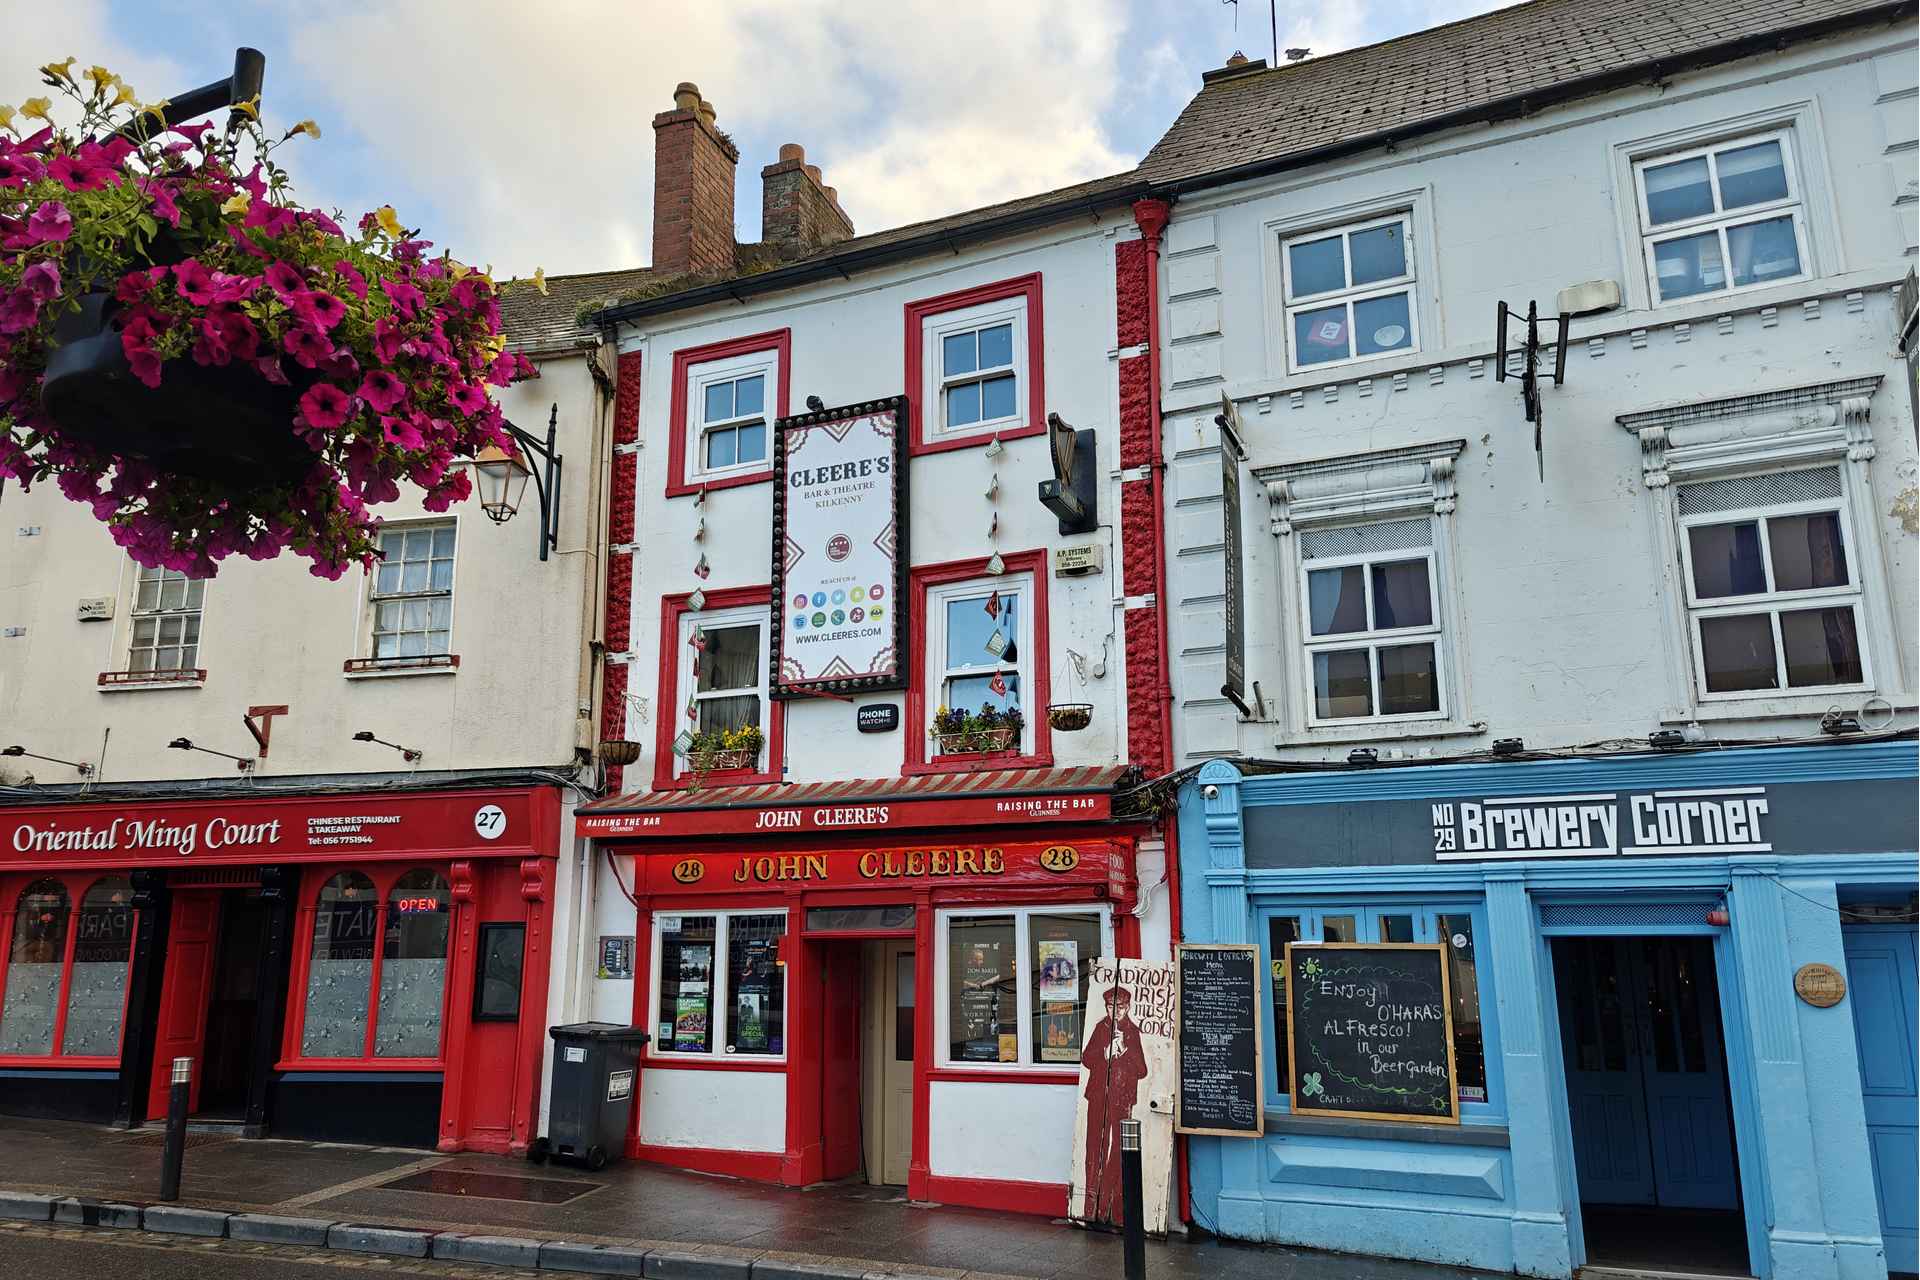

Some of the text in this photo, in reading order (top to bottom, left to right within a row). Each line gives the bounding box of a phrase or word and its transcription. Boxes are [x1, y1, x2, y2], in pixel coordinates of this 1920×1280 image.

[790, 456, 890, 488] CLEERE'S
[804, 481, 875, 500] BAR & THEATRE
[815, 495, 863, 509] KILKENNY
[1068, 546, 1092, 557] SYSTEMS
[795, 626, 882, 645] WWW.CLEERES.COM
[859, 709, 892, 720] PHONE
[997, 799, 1095, 811] RAISING THE BAR
[1432, 803, 1454, 826] NO
[307, 815, 402, 826] CHINESE RESTAURANT
[477, 811, 502, 830] 27
[586, 816, 661, 827] RAISING THE BAR
[755, 806, 889, 828] JOHN CLEERE'S
[1460, 795, 1769, 853] Brewery Corner
[13, 817, 281, 855] Oriental Ming Court
[314, 825, 362, 833] TAKEAWAY
[307, 836, 322, 845] Tel:
[322, 836, 339, 845] 056
[1434, 828, 1456, 851] 29
[733, 848, 1005, 883] JOHN CLEERE
[1047, 848, 1074, 867] 28
[680, 862, 700, 878] 28
[399, 898, 437, 911] OPEN
[1094, 966, 1175, 986] TRADITION
[1323, 1019, 1344, 1036] AL
[1357, 1039, 1400, 1055] in our
[1369, 1055, 1448, 1079] Beer Garden
